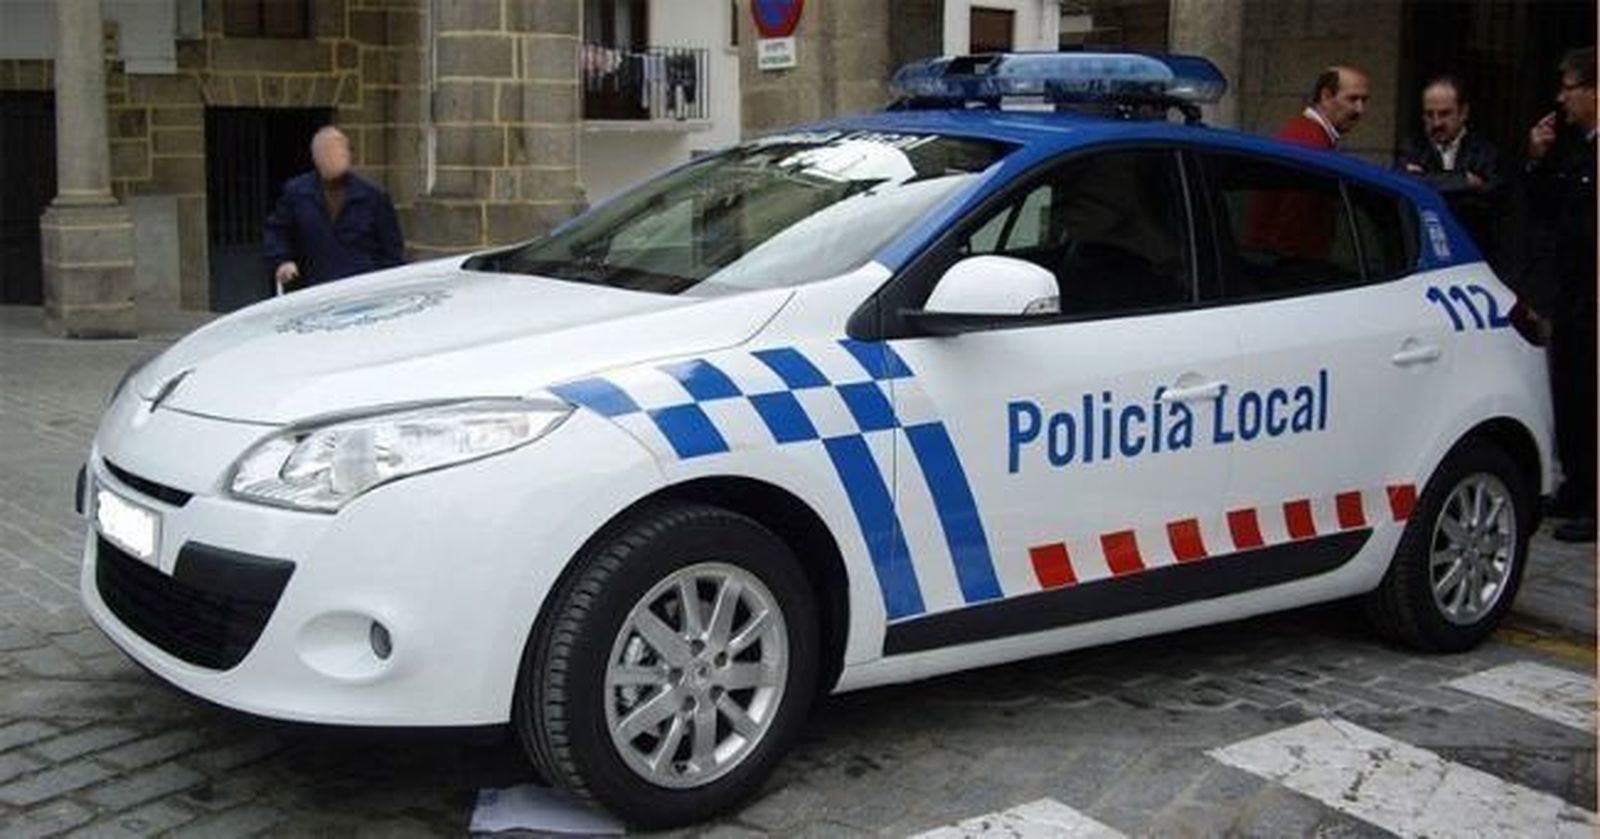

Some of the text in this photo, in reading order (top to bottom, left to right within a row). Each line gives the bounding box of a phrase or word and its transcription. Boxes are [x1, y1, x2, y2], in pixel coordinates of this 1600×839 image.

[1426, 285, 1510, 332] 112
[1007, 369, 1328, 473] Policía Local
